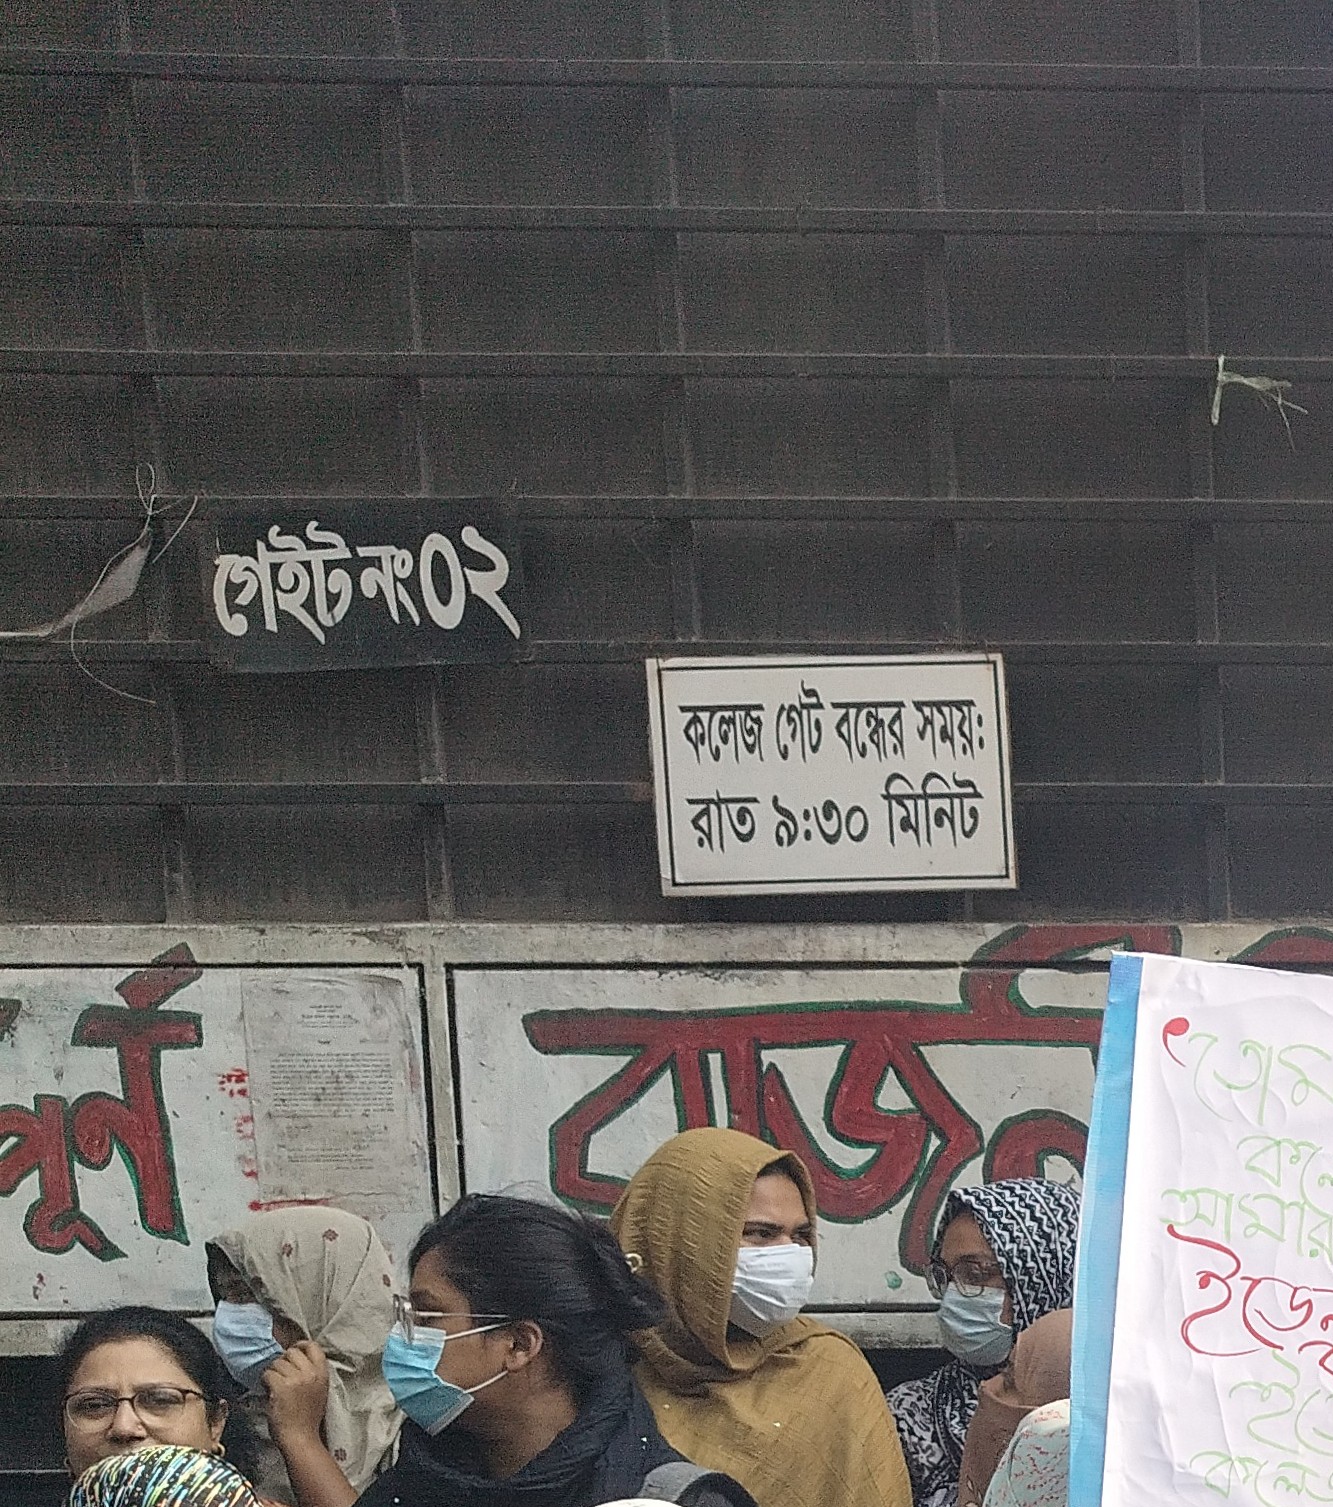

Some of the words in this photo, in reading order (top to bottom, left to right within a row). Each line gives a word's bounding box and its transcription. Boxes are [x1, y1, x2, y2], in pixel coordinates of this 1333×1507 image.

[214, 521, 353, 645] গেইট
[356, 545, 420, 626] নং
[678, 703, 765, 764] কলেজ
[775, 680, 826, 763] গেট
[830, 700, 906, 763] বন্ধের
[686, 789, 760, 853] রাত
[771, 795, 869, 847] ৯:৩০
[881, 771, 984, 847] মিনিট
